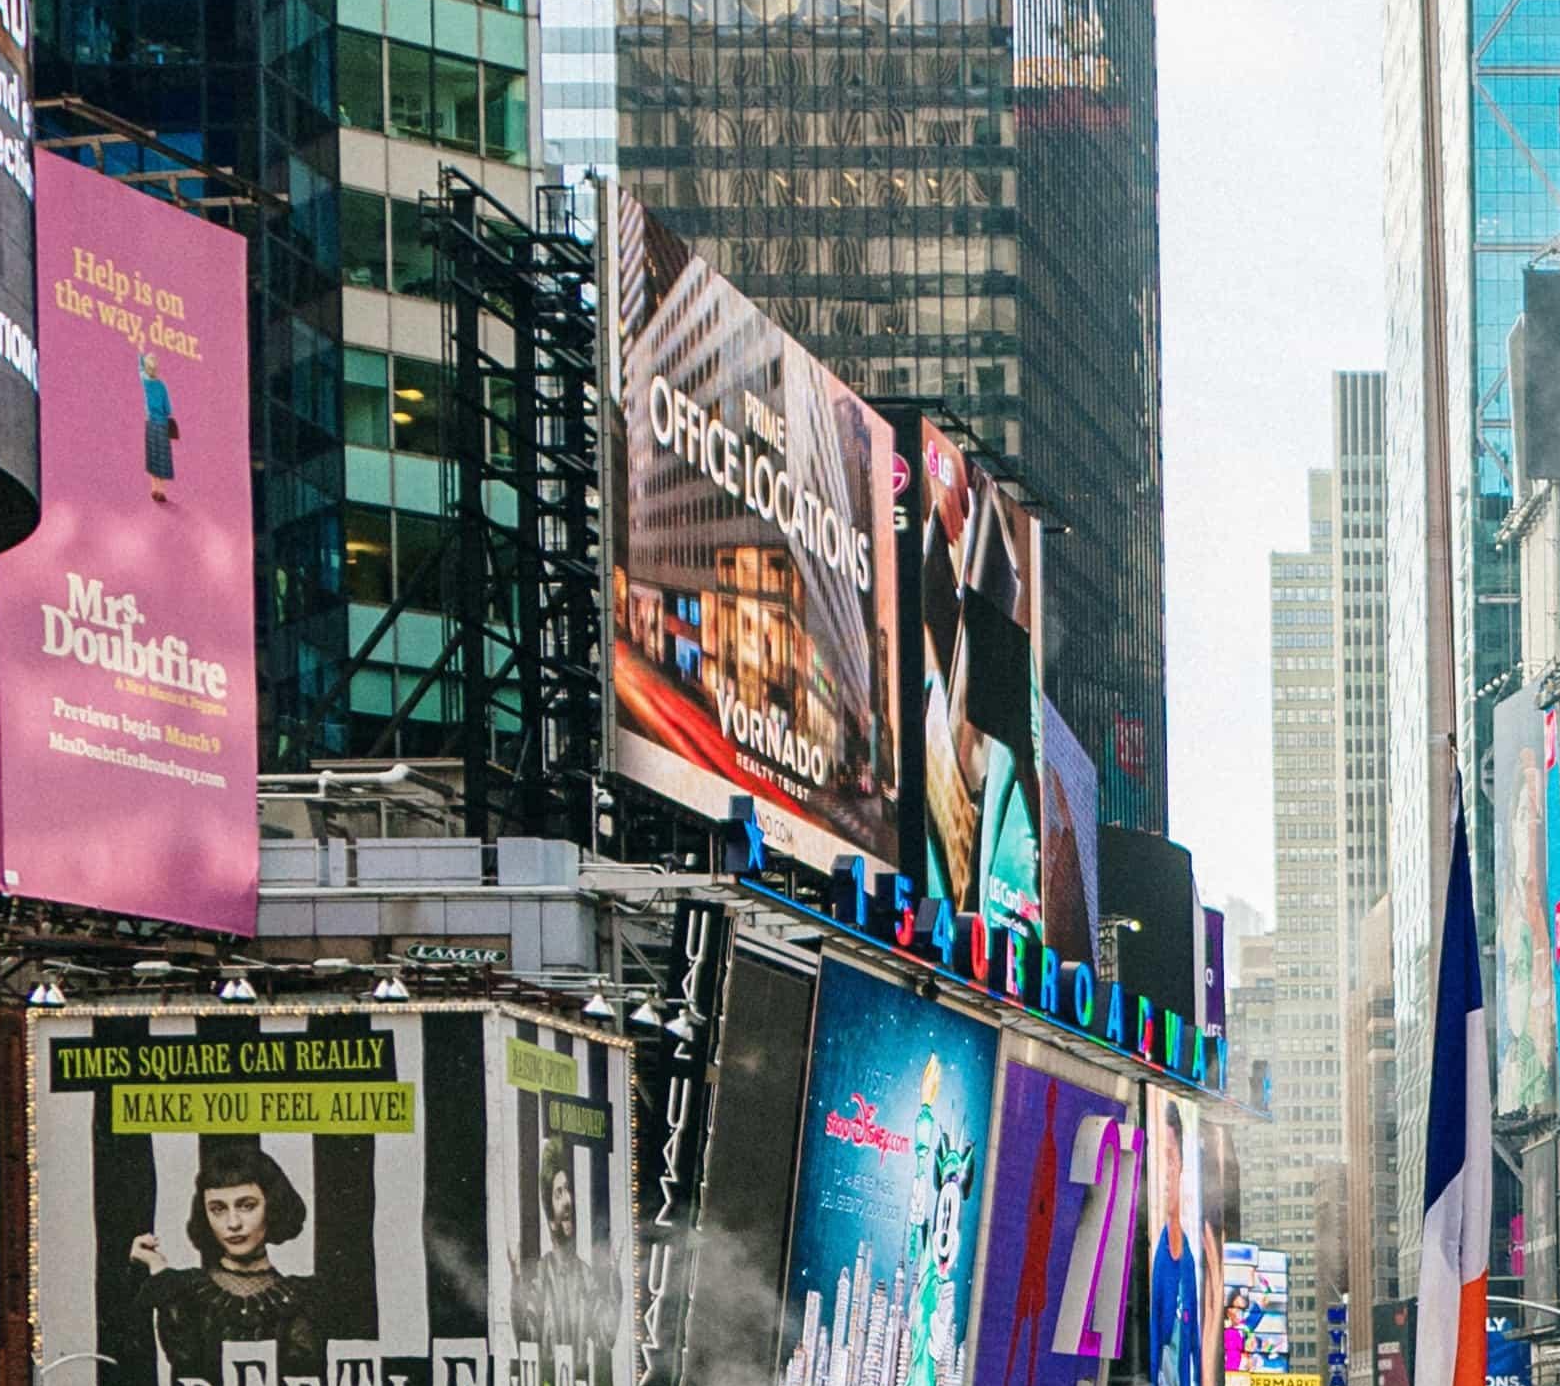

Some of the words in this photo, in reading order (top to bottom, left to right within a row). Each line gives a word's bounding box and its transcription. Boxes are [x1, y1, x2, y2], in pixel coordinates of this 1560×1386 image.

[72, 248, 129, 302] Help
[133, 270, 153, 309] is
[156, 286, 185, 322] on
[54, 277, 94, 318] the
[149, 314, 203, 362] dear.
[743, 390, 787, 456] PRIME
[649, 373, 740, 497] OFFICE
[744, 447, 873, 594] LOCATIONS
[66, 572, 145, 627] Mrs.
[41, 604, 227, 700] Doubtfire
[52, 697, 119, 735] Previews
[121, 712, 161, 744] begin
[164, 723, 210, 756] March
[713, 681, 826, 788] VORNADO
[48, 731, 227, 790] MrsDoubtfireBroadway.com
[777, 773, 811, 802] TRUST
[58, 1045, 132, 1080] TIMES
[139, 1043, 231, 1077] SQUARE
[239, 1040, 286, 1074] CAN
[295, 1037, 386, 1071] REALLY
[122, 1092, 193, 1124] MAKE
[201, 1092, 250, 1123] YOU
[259, 1091, 319, 1122] FEEL
[330, 1089, 408, 1122] ALIVE!
